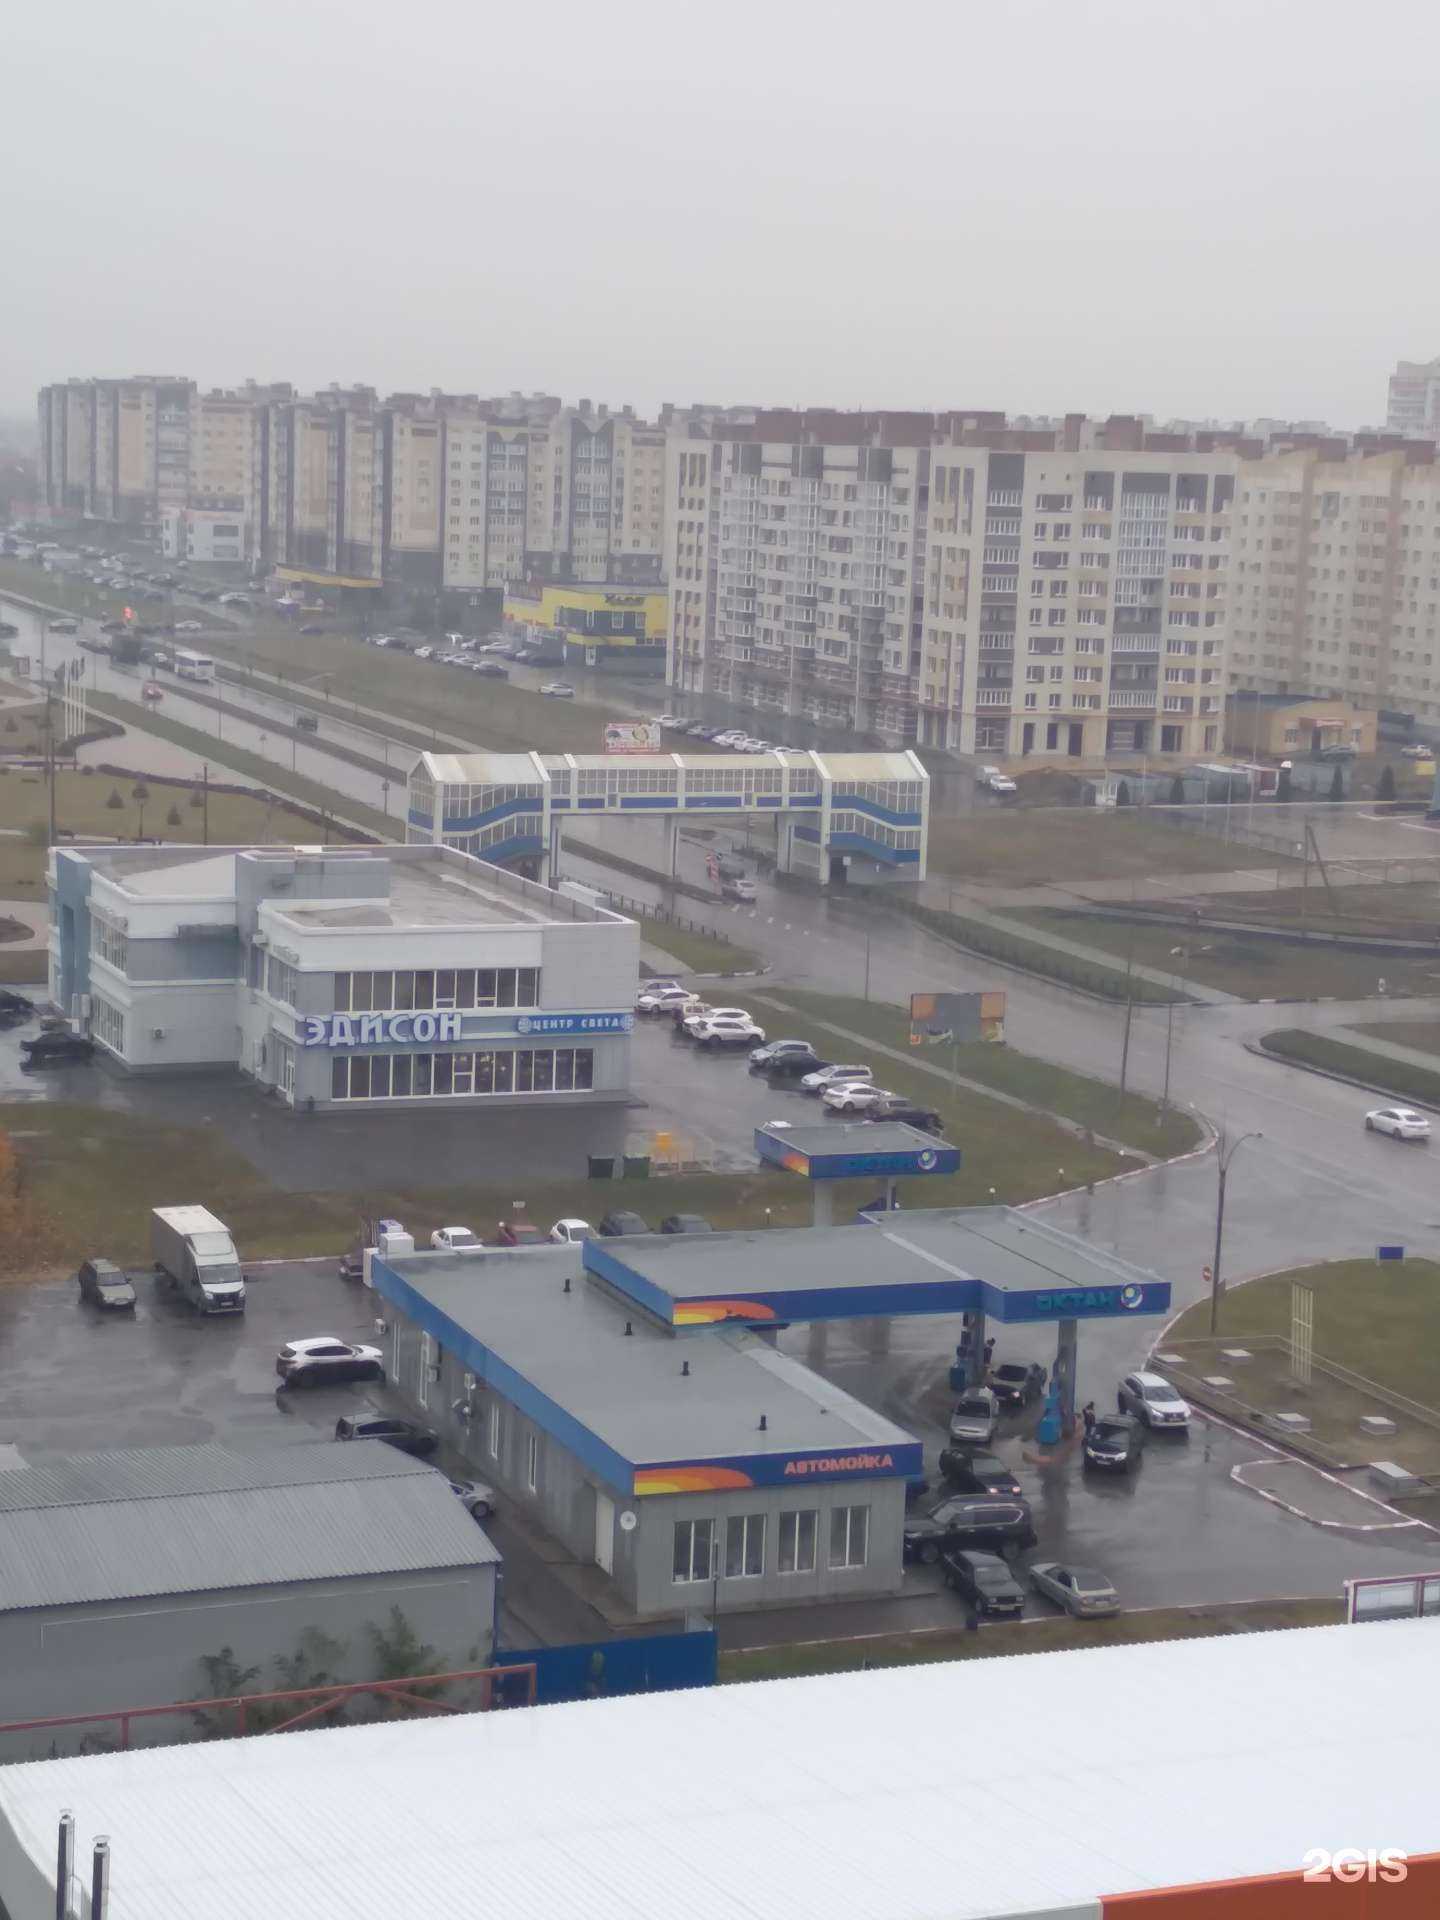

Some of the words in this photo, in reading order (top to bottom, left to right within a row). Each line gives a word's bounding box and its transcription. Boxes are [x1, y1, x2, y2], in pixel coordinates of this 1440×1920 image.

[304, 1012, 463, 1047] ЭДИСОН
[532, 1019, 574, 1031] ЦЕНТР
[581, 1017, 619, 1028] СВЕТА
[784, 1454, 894, 1475] АВТОМОЙКА
